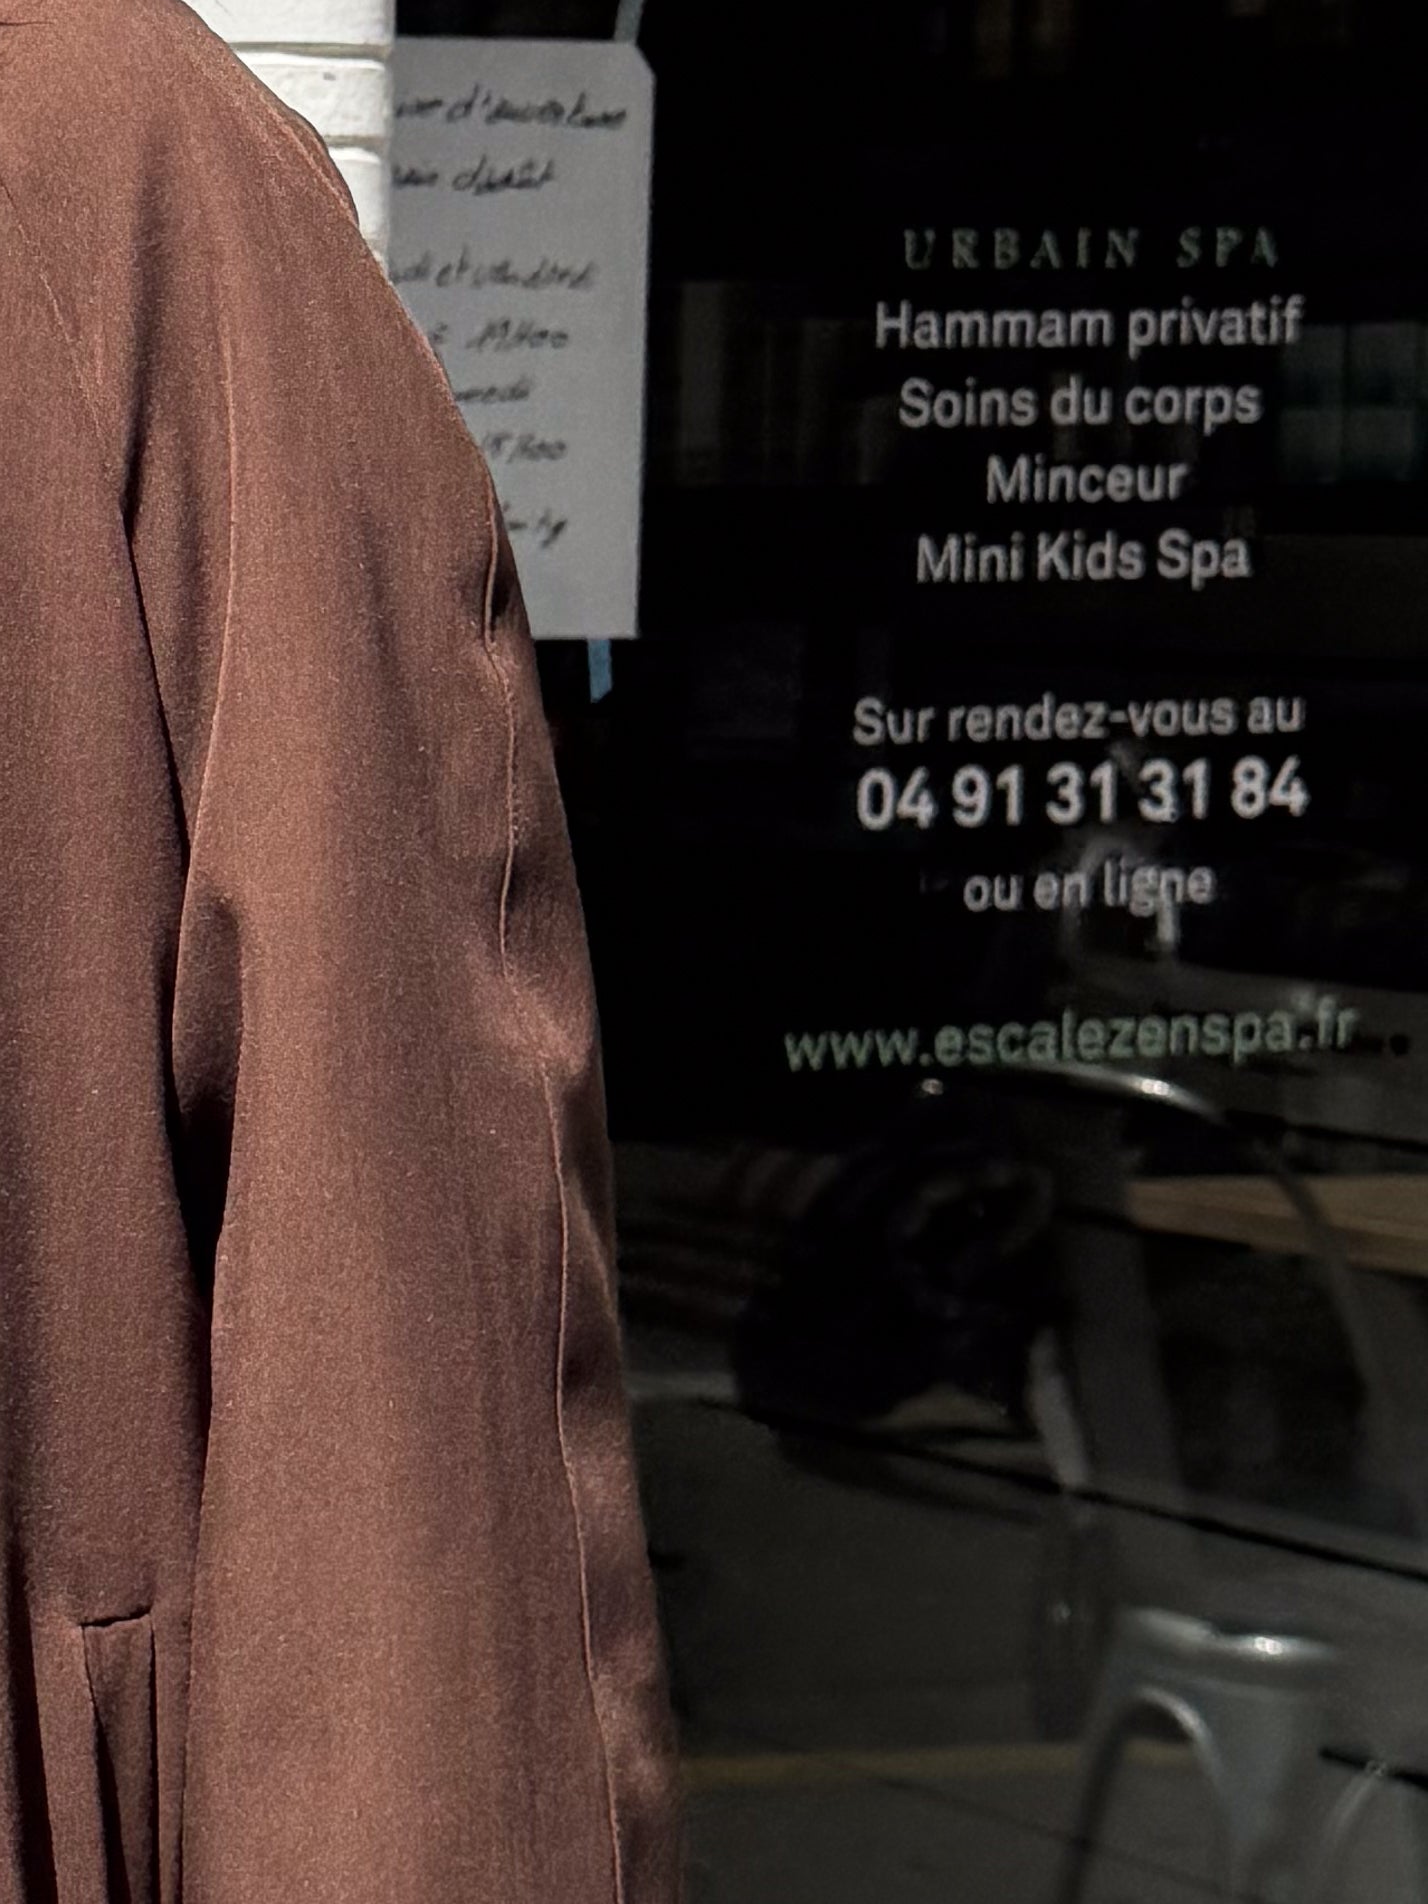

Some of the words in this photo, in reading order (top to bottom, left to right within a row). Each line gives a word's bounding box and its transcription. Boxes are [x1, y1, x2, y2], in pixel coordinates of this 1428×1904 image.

[903, 228, 1139, 269] URBAIN
[1177, 227, 1277, 268] SPA
[876, 302, 1111, 348] Hammam
[1128, 295, 1302, 359] privatif
[899, 378, 1035, 428] Soins
[1050, 376, 1109, 425] du
[1125, 385, 1260, 435] corps
[987, 456, 1187, 502] Minceur
[917, 535, 1020, 582] Mini
[1038, 532, 1142, 579] Kids
[1157, 529, 1249, 588] Spa
[853, 697, 934, 745] Sur
[948, 691, 1235, 743] rendez-vous
[1247, 695, 1304, 734] au
[858, 769, 934, 829] 04
[953, 767, 1020, 826] 91
[1047, 762, 1113, 823] 31
[1140, 760, 1207, 822] 31
[1232, 758, 1307, 816] 84
[963, 876, 1019, 911] ou
[1034, 871, 1088, 908] en
[1104, 860, 1213, 917] ligne
[784, 998, 1357, 1070] www.escalezenspa.fr
